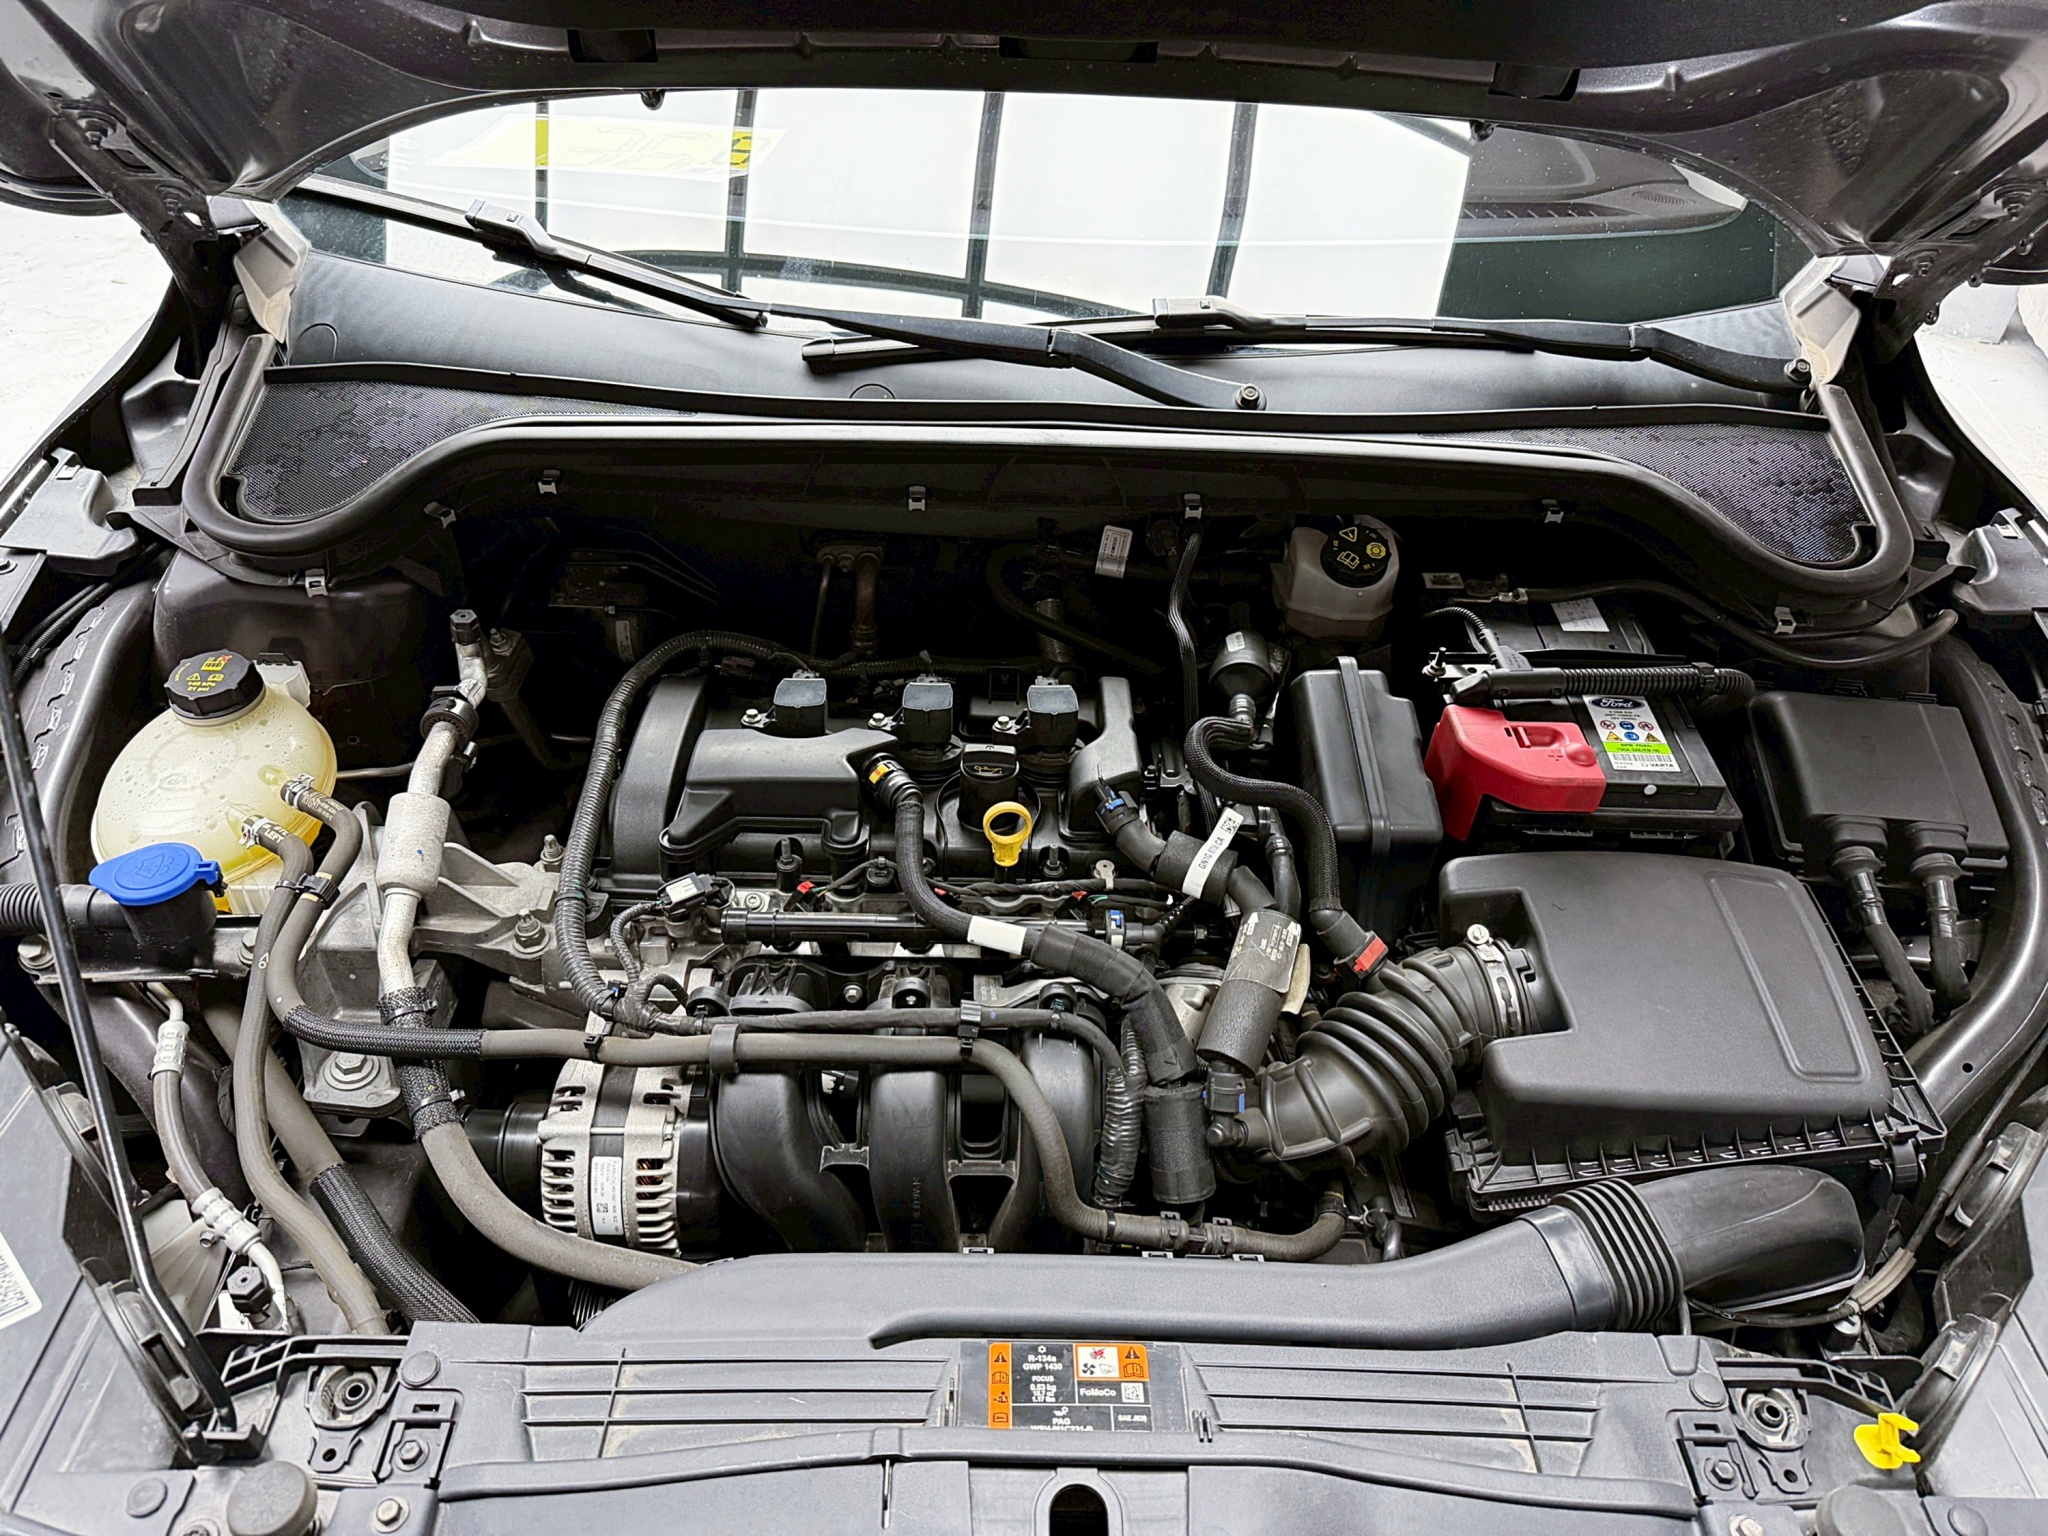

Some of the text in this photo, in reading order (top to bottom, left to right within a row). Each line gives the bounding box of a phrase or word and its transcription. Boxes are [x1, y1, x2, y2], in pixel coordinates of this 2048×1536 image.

[1600, 698, 1634, 709] Ford
[264, 828, 285, 844] LEFT
[1047, 1384, 1056, 1392] kg
[1080, 1388, 1116, 1396] FoMoCo
